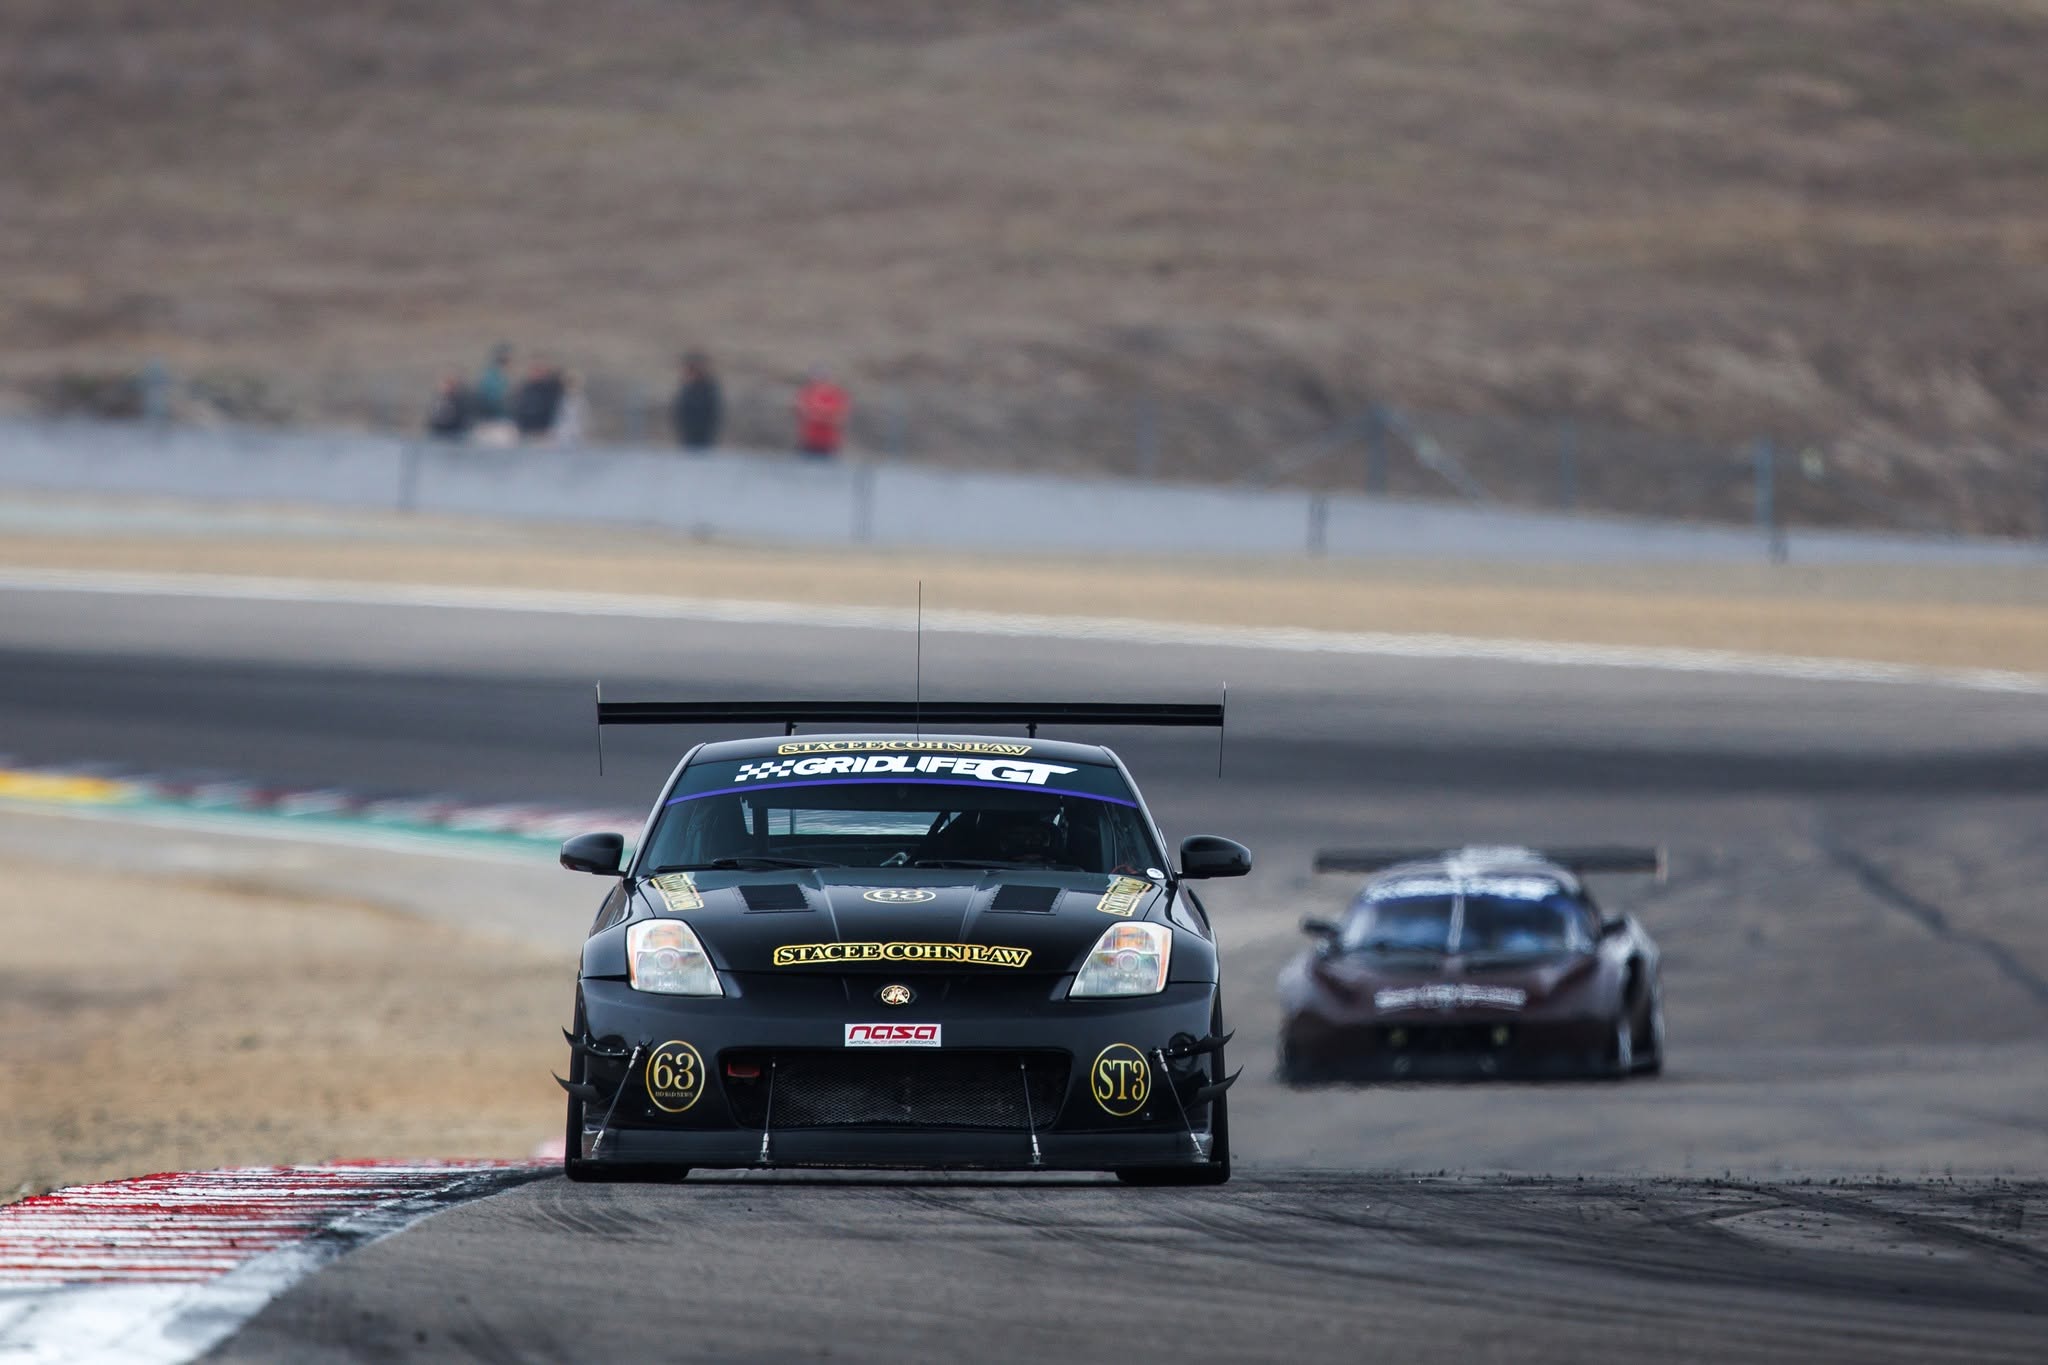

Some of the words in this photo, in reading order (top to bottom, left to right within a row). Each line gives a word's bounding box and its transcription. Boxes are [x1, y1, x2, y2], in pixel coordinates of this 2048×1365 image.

[784, 741, 884, 752] STACEE
[886, 741, 966, 750] COHN
[970, 743, 1030, 755] LAW
[793, 756, 985, 776] GRIDLIFE
[873, 890, 924, 899] 63
[780, 944, 880, 962] STACEE
[886, 944, 965, 959] COHN
[970, 947, 1026, 966] LAW
[653, 1052, 695, 1090] 63
[1098, 1058, 1146, 1101] ST3
